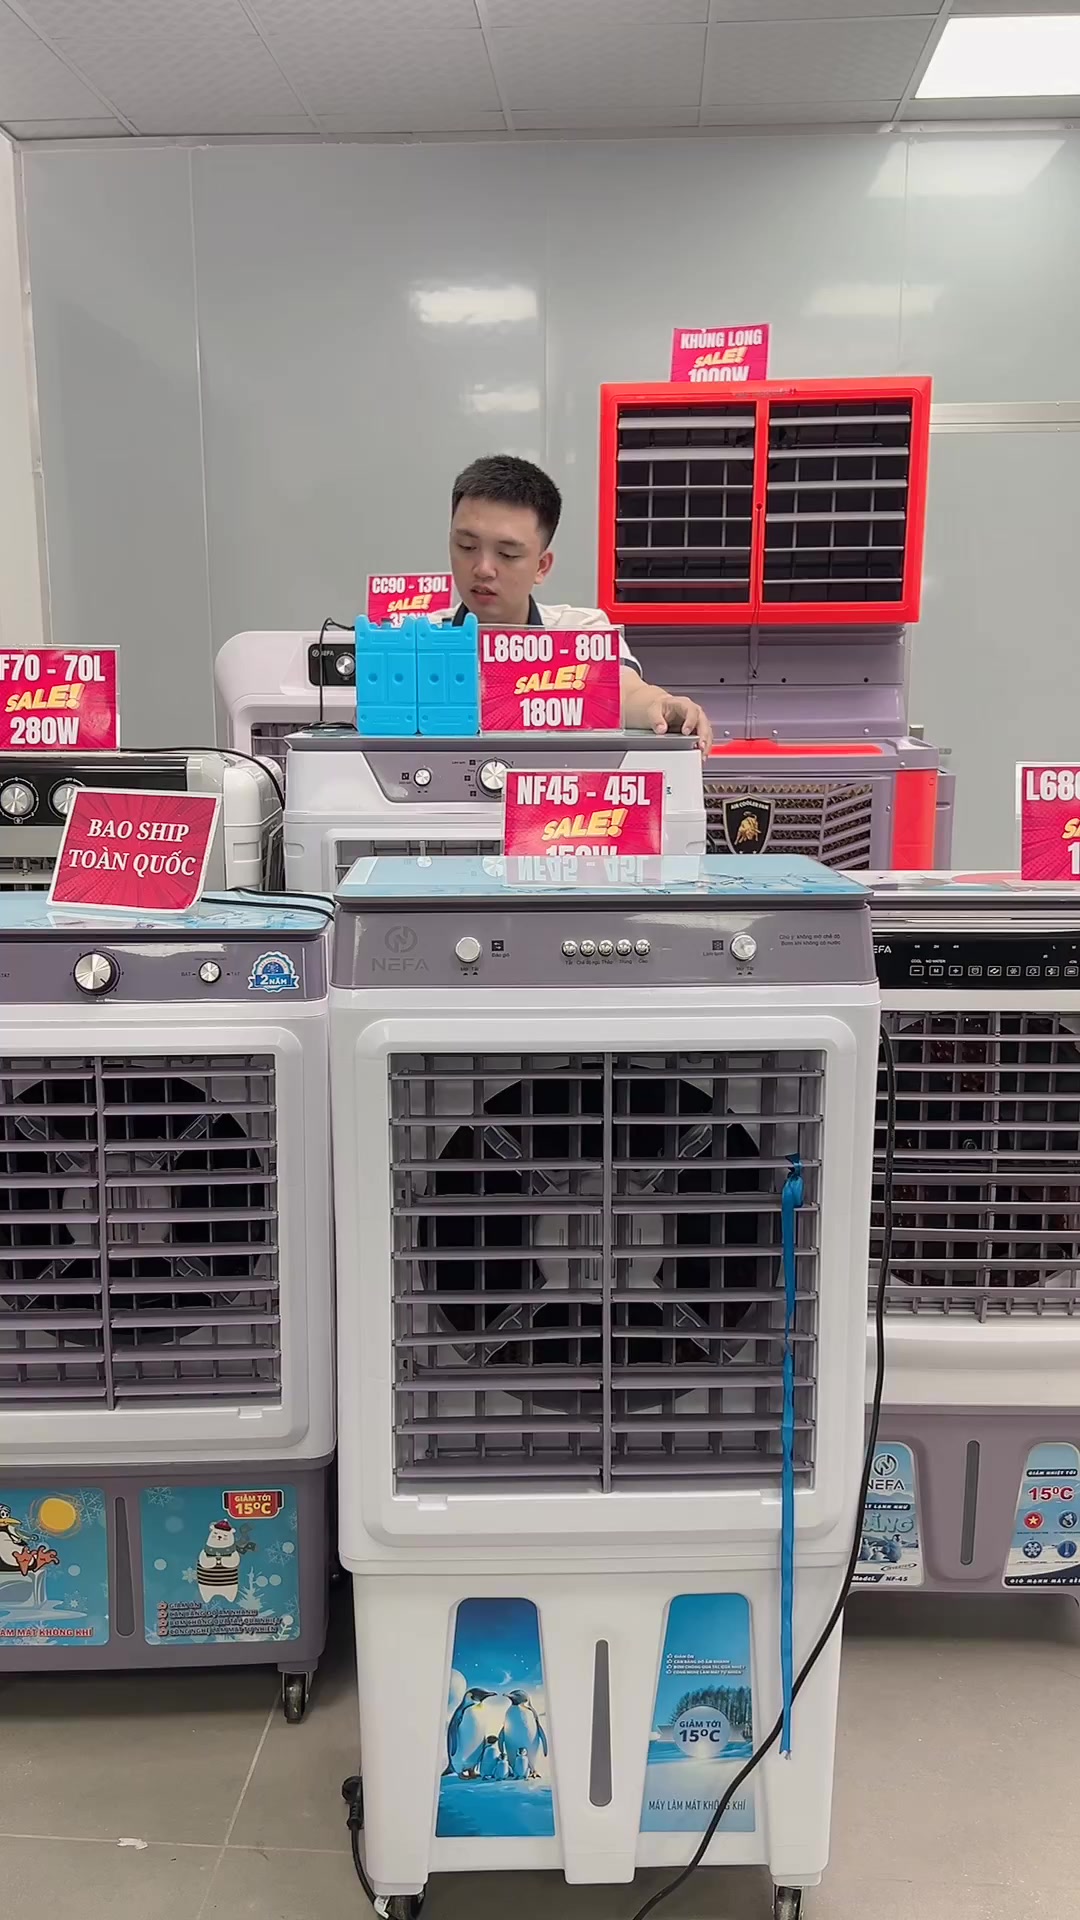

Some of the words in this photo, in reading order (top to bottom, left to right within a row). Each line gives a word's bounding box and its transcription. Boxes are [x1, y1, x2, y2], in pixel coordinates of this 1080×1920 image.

[680, 328, 725, 349] KHỦNG
[728, 329, 763, 347] LONG
[693, 346, 749, 369] SALE!
[372, 577, 406, 594] CC90
[417, 576, 449, 593] 130L
[386, 593, 432, 613] SALE!
[483, 634, 553, 663] L8600
[575, 634, 617, 661] 80L
[64, 655, 106, 682] 70L
[513, 664, 590, 695] SALE!
[5, 683, 85, 713] SALE!
[520, 698, 584, 727] 180W
[10, 716, 79, 745] 280W
[517, 775, 579, 806] NF45
[604, 775, 651, 806] 45L
[87, 818, 133, 839] BAO
[137, 821, 189, 843] SHIP
[541, 808, 629, 841] SALE!
[69, 847, 129, 871] TOÀN
[133, 850, 196, 877] QUỐC
[371, 957, 430, 972] NEFA
[260, 974, 268, 985] 2
[234, 1494, 256, 1502] GIẢM
[679, 1719, 703, 1728] GIẢM
[706, 1720, 721, 1728] TỚI
[649, 1799, 665, 1810] MÁY
[667, 1799, 682, 1810] LÀM
[685, 1799, 700, 1810] MÁT
[703, 1799, 730, 1810] KHÔG
[732, 1799, 746, 1810] KHÍ
